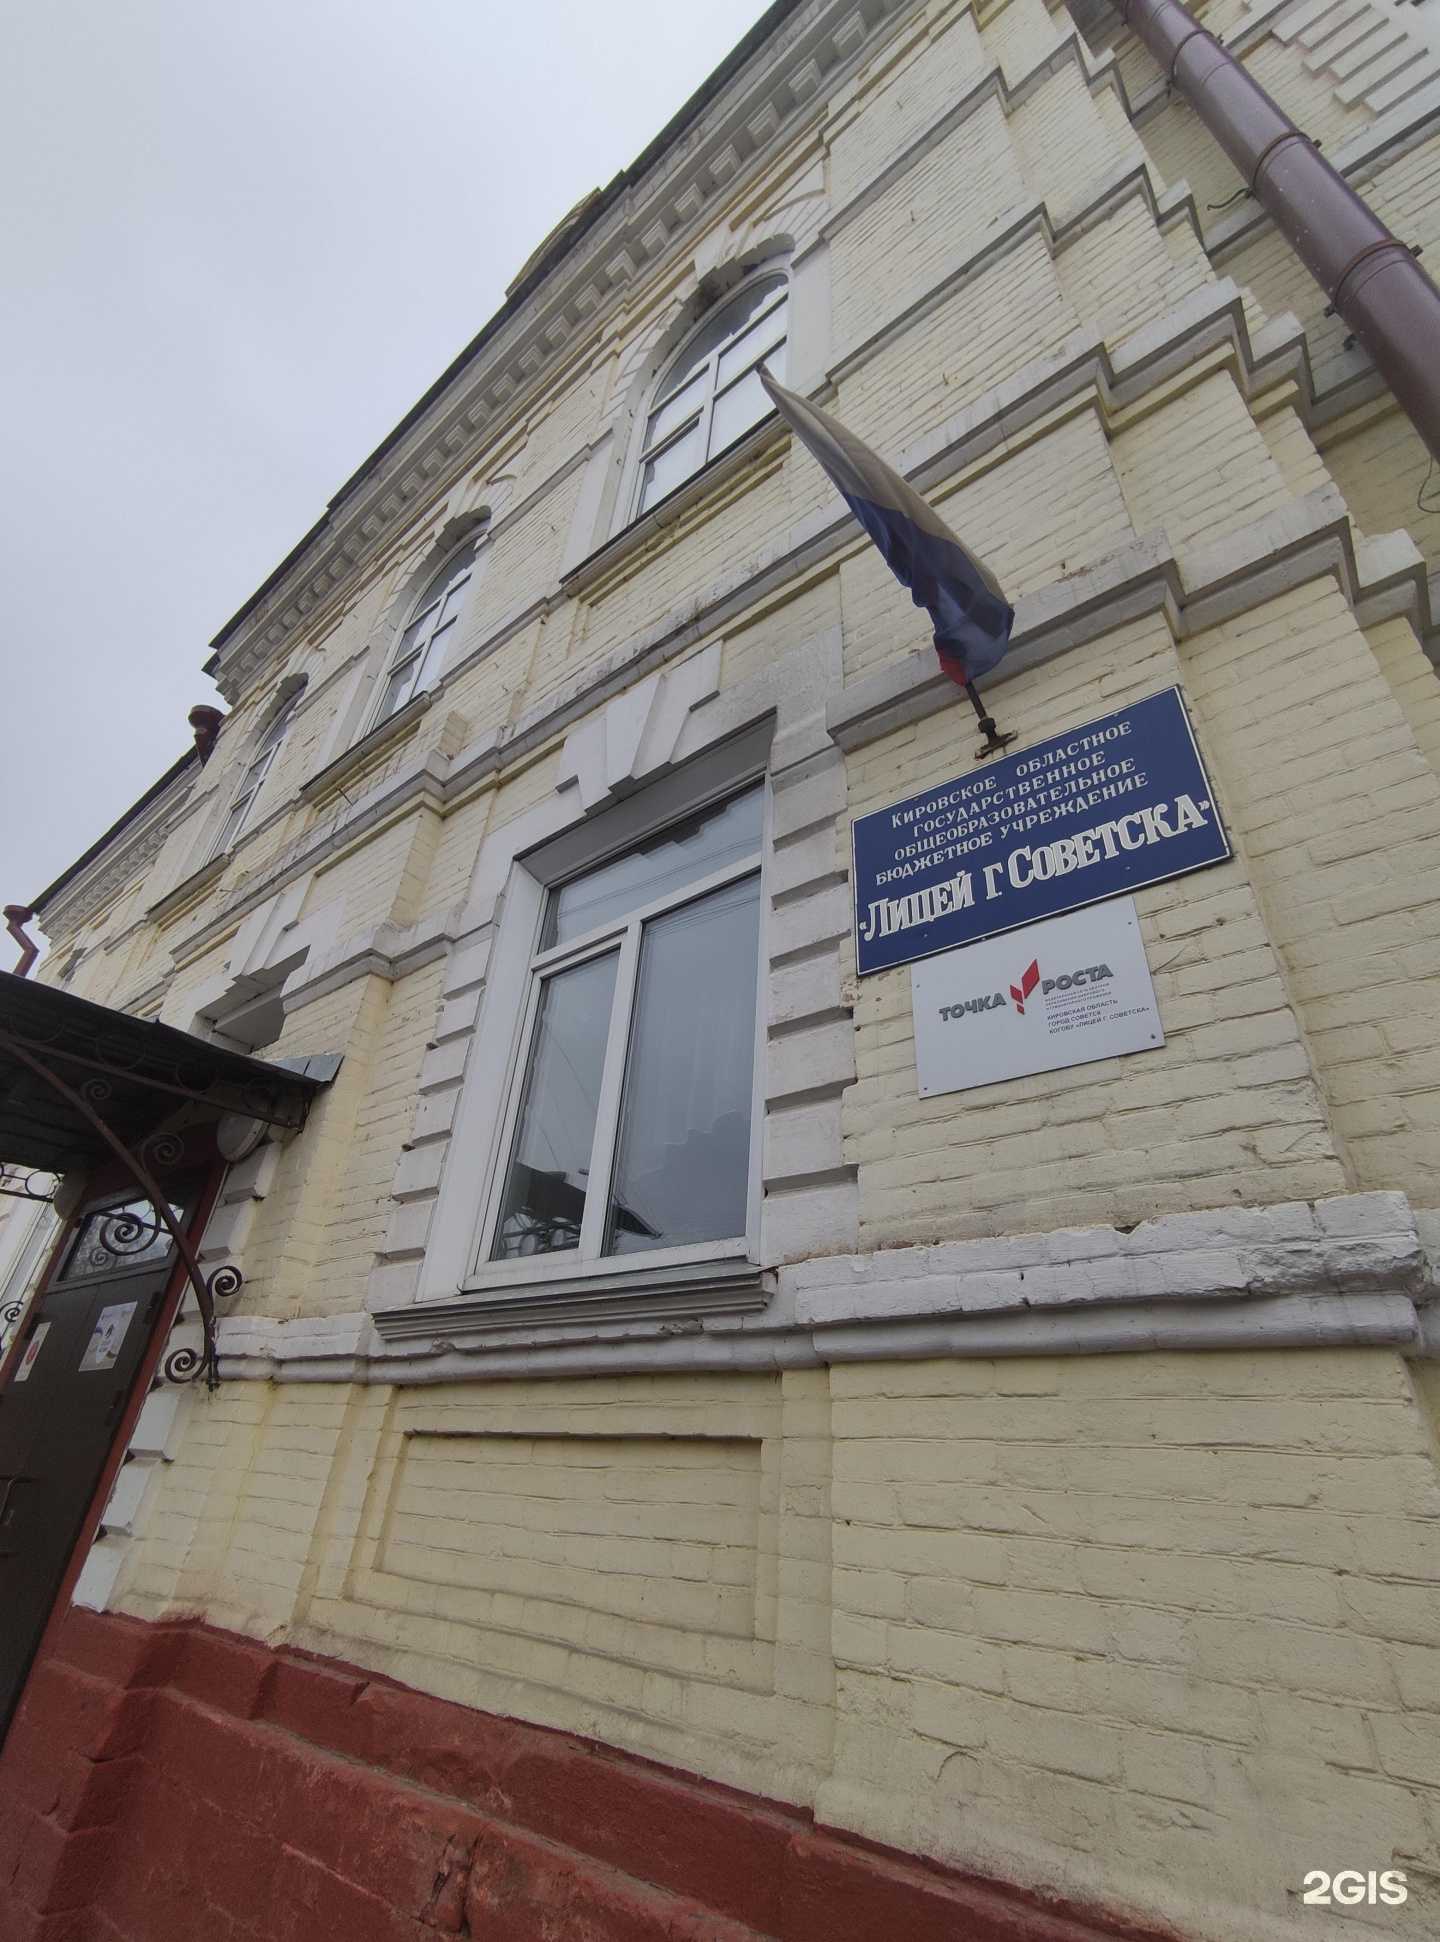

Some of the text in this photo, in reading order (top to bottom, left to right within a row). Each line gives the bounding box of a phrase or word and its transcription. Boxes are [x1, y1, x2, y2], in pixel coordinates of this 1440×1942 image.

[892, 721, 1132, 828] КИРОВСКОЕ ОБЛАСТНОЕ
[895, 758, 1136, 861] ОБЩЕОБРАЗОВАТЕЛЬНОЕ
[913, 751, 1106, 837] ГОСУДАРСТВЕННОЕ
[876, 772, 1149, 886] БЮДЖЕТНОЕ УЧРЕЖДЕНИЕ
[938, 963, 1114, 1021] ТОЧКА РОСТА
[1047, 999, 1118, 1020] КИРОВСКАЯ ОБЛАСТЬ
